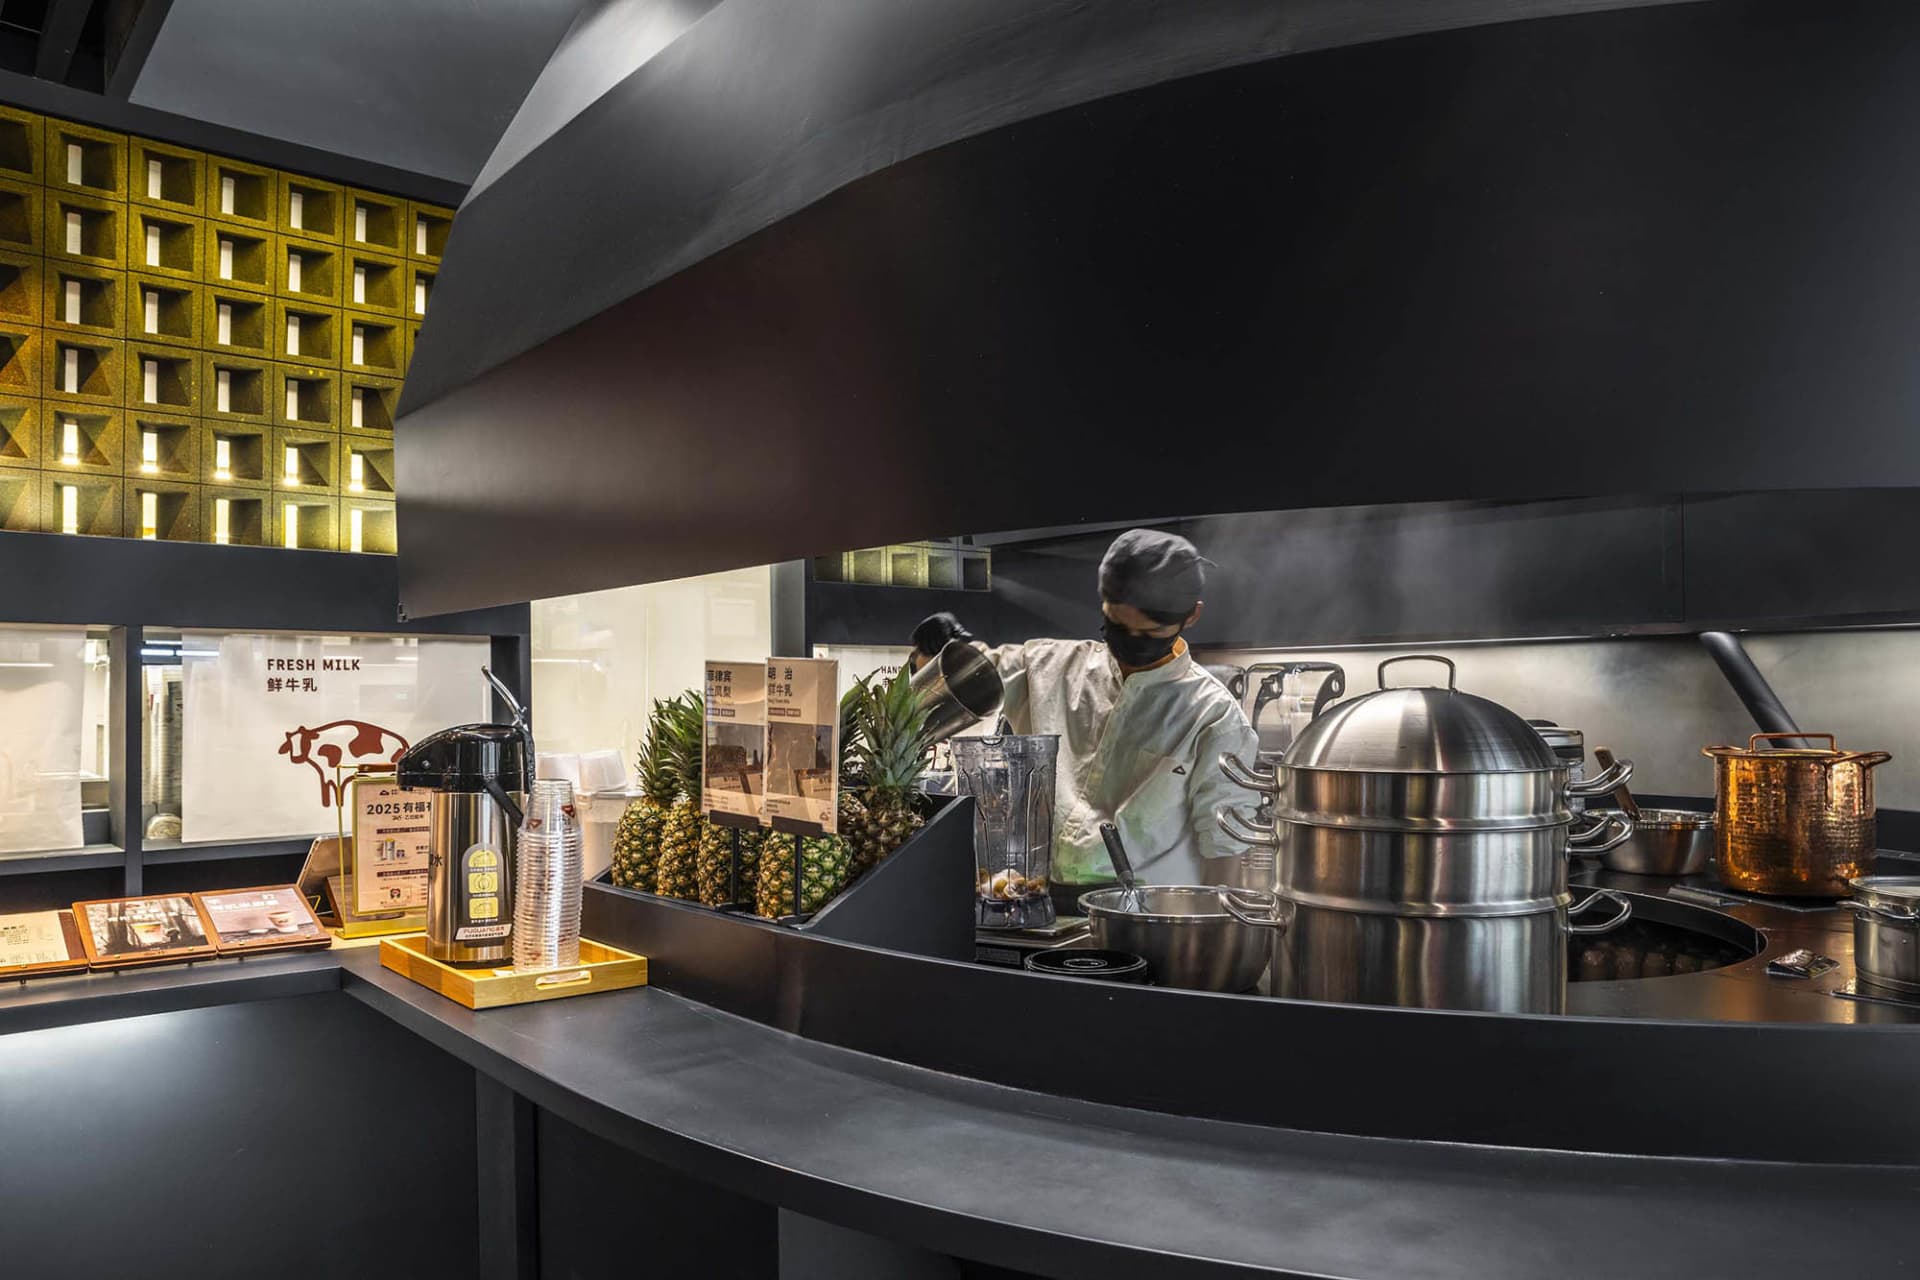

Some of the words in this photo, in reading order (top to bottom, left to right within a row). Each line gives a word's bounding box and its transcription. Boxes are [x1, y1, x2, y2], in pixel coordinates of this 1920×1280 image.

[267, 659, 315, 671] FRESH
[323, 659, 360, 671] MILK
[267, 677, 318, 692] 鲜牛乳
